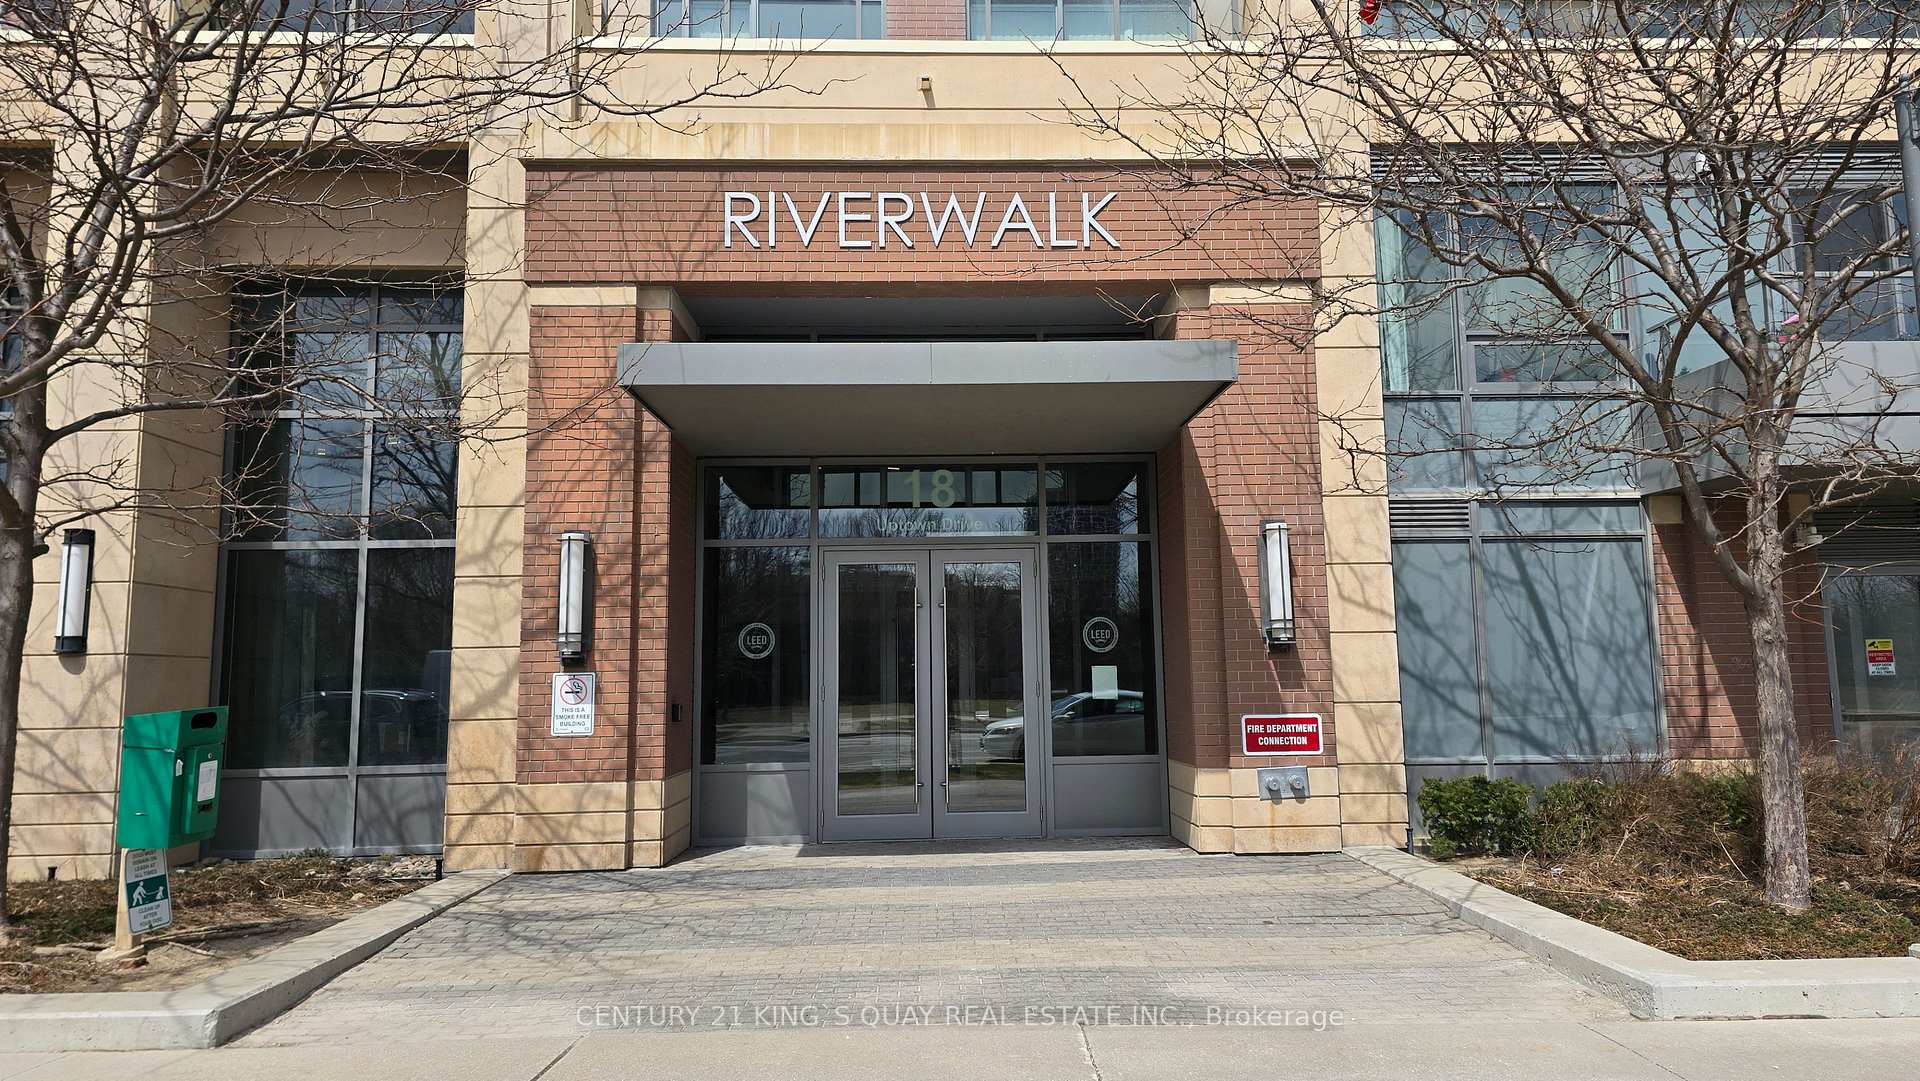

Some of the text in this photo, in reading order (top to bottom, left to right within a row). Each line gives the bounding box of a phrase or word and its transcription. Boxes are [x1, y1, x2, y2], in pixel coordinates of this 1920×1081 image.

[724, 191, 1121, 249] RIVERWALK
[904, 469, 955, 508] 18
[877, 518, 982, 534] Uptown Drive
[1091, 629, 1111, 639] LEED
[746, 635, 767, 645] LEED
[1247, 723, 1317, 733] FIRE DEPARTMENT
[1258, 736, 1308, 745] CONNECTION
[143, 912, 158, 920] AFTER
